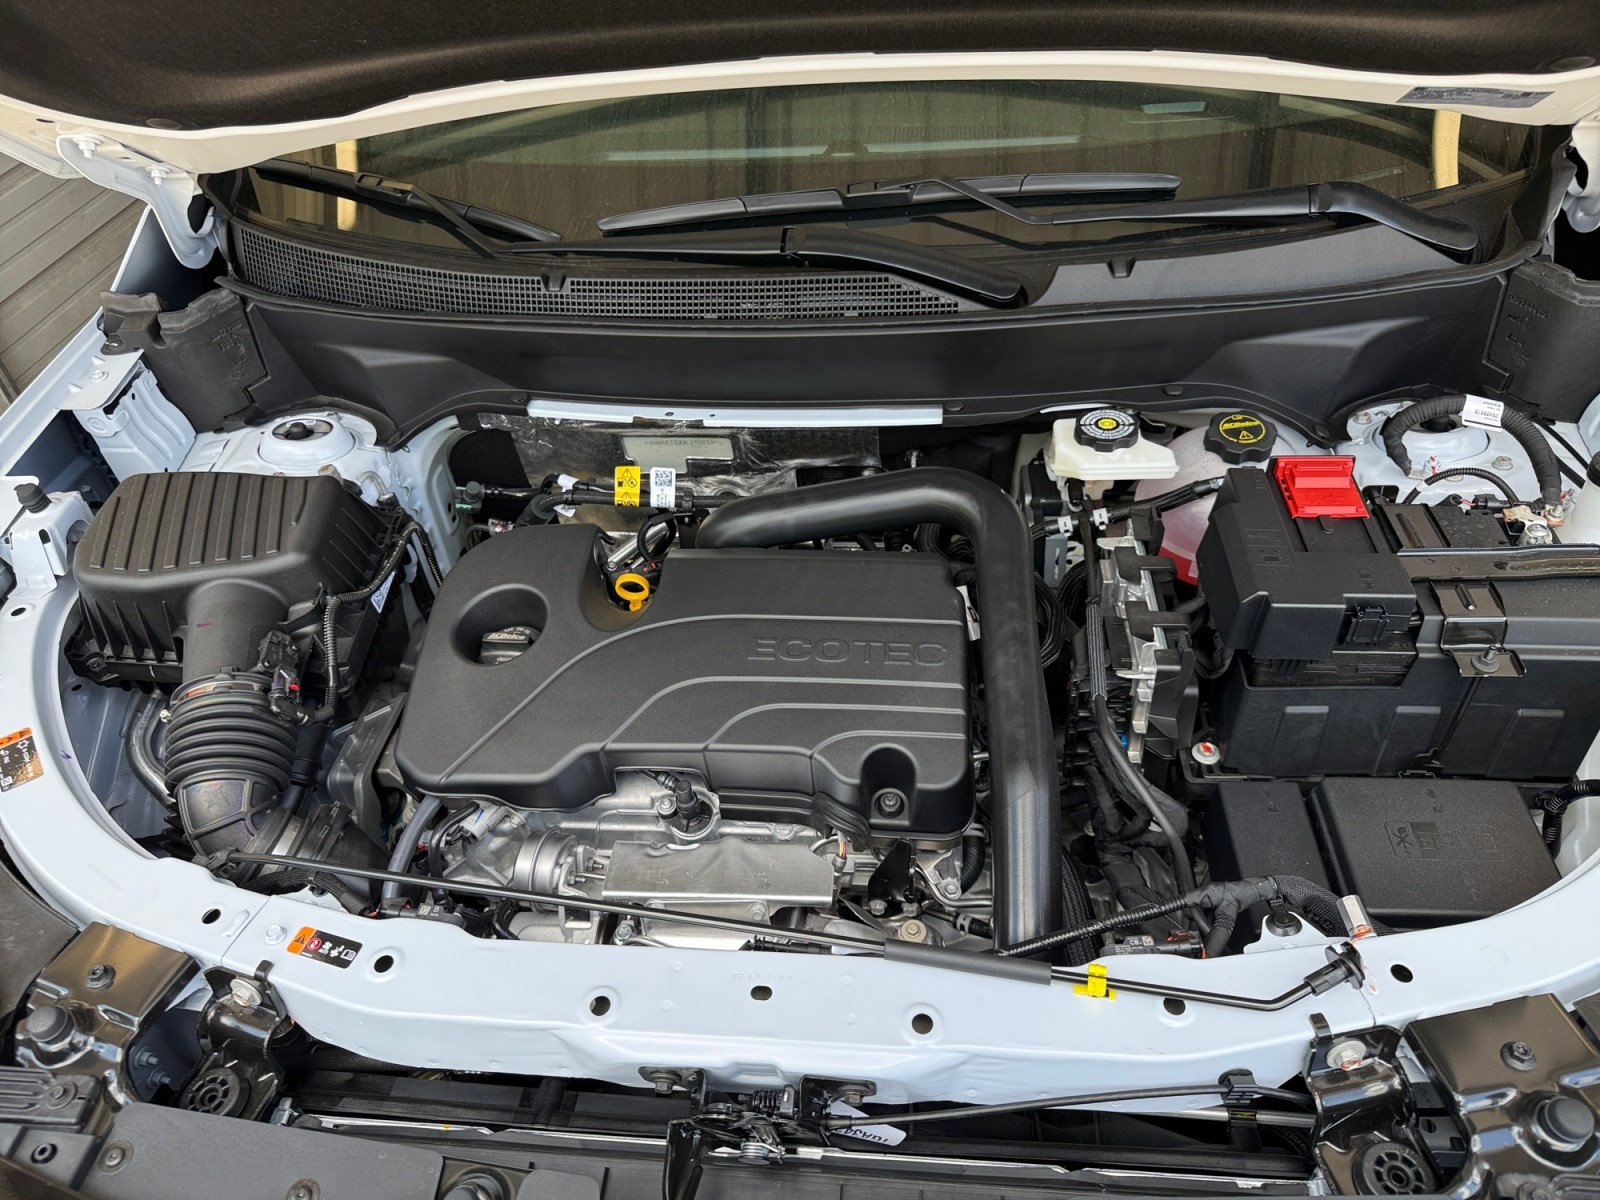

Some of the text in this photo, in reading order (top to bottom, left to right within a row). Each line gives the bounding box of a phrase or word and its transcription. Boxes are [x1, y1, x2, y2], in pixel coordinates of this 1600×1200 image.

[1222, 420, 1260, 429] ACDelco
[487, 632, 526, 640] ACDelco
[747, 636, 948, 667] ECOTEC
